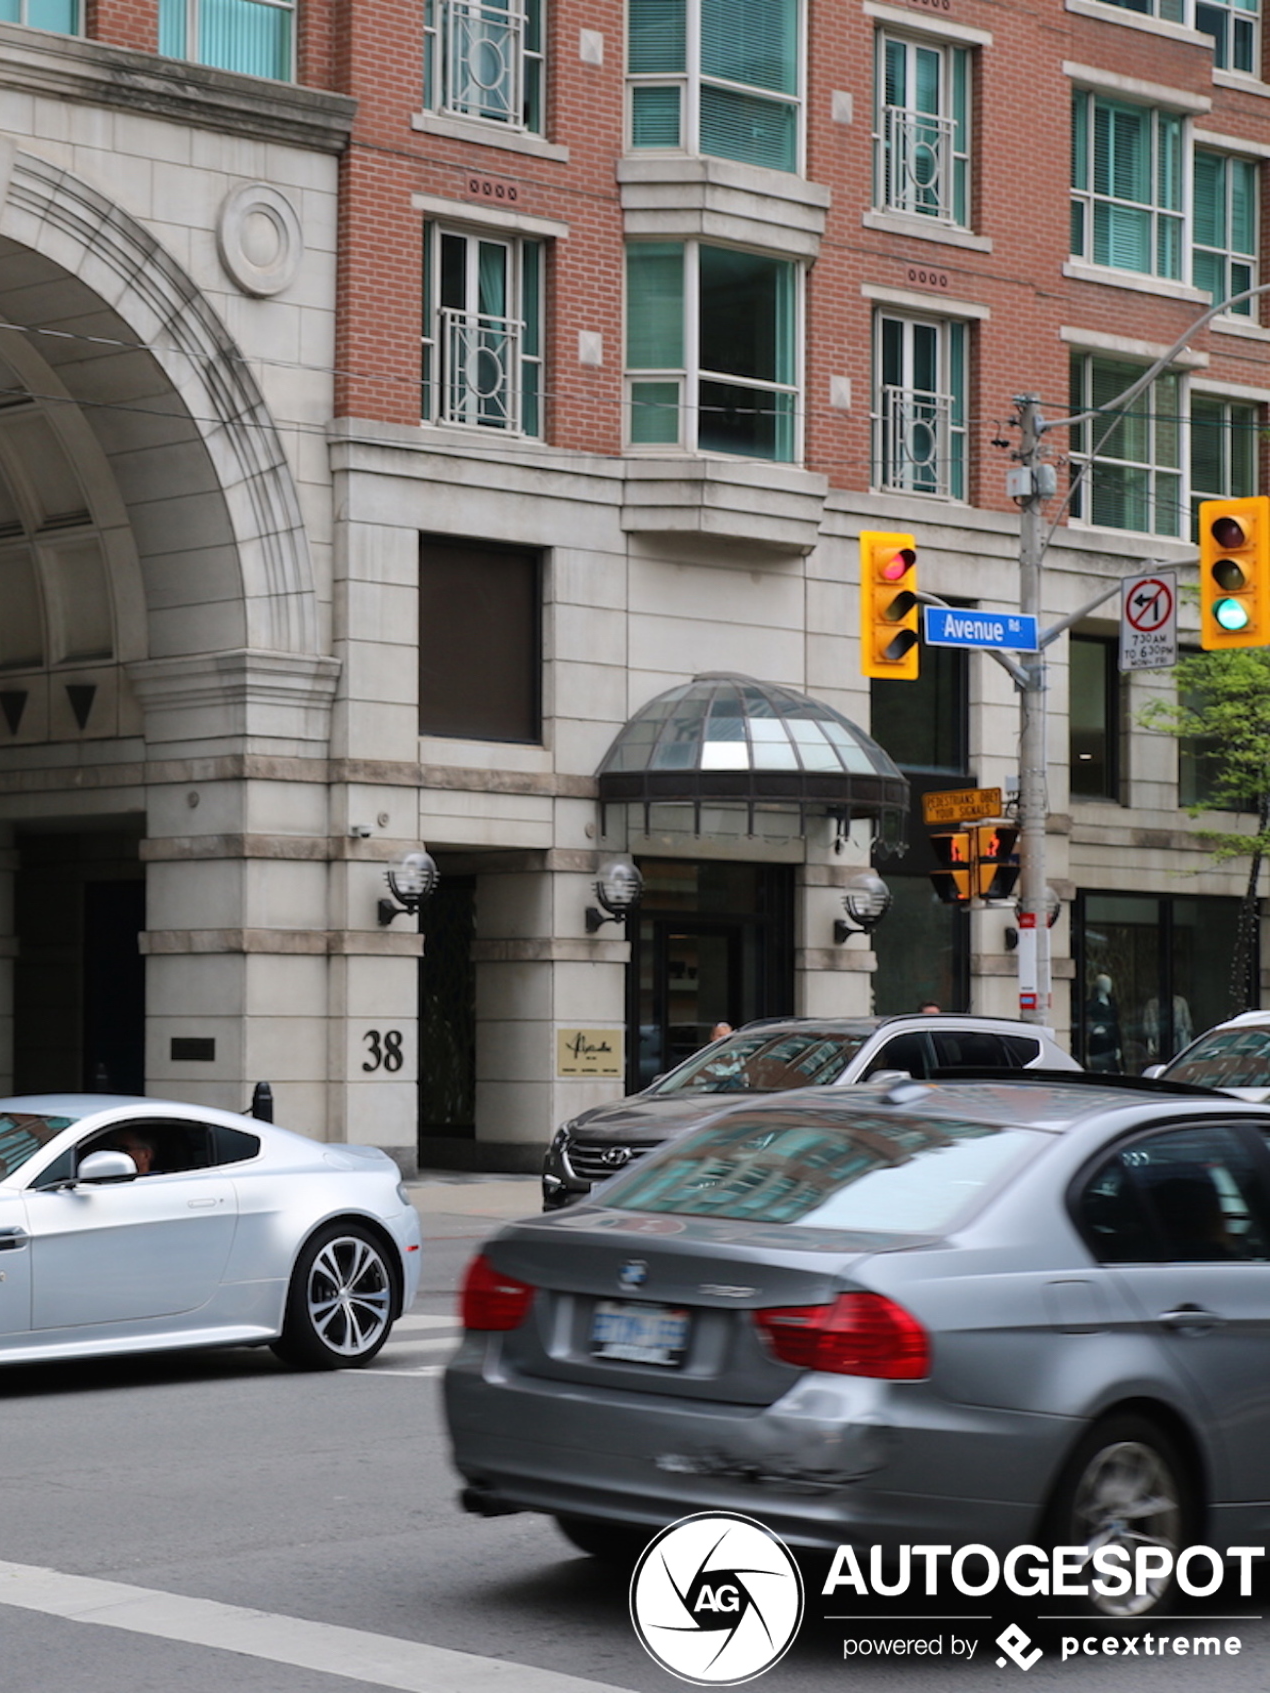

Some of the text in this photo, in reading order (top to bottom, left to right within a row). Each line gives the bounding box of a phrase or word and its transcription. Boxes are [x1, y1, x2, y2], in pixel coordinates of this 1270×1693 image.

[944, 614, 1020, 641] Avenue Rd
[1124, 649, 1137, 659] TO
[927, 791, 998, 808] PEDESTRIANS OBEY
[935, 804, 990, 819] YOUR SIGNALS
[362, 1029, 403, 1072] 38
